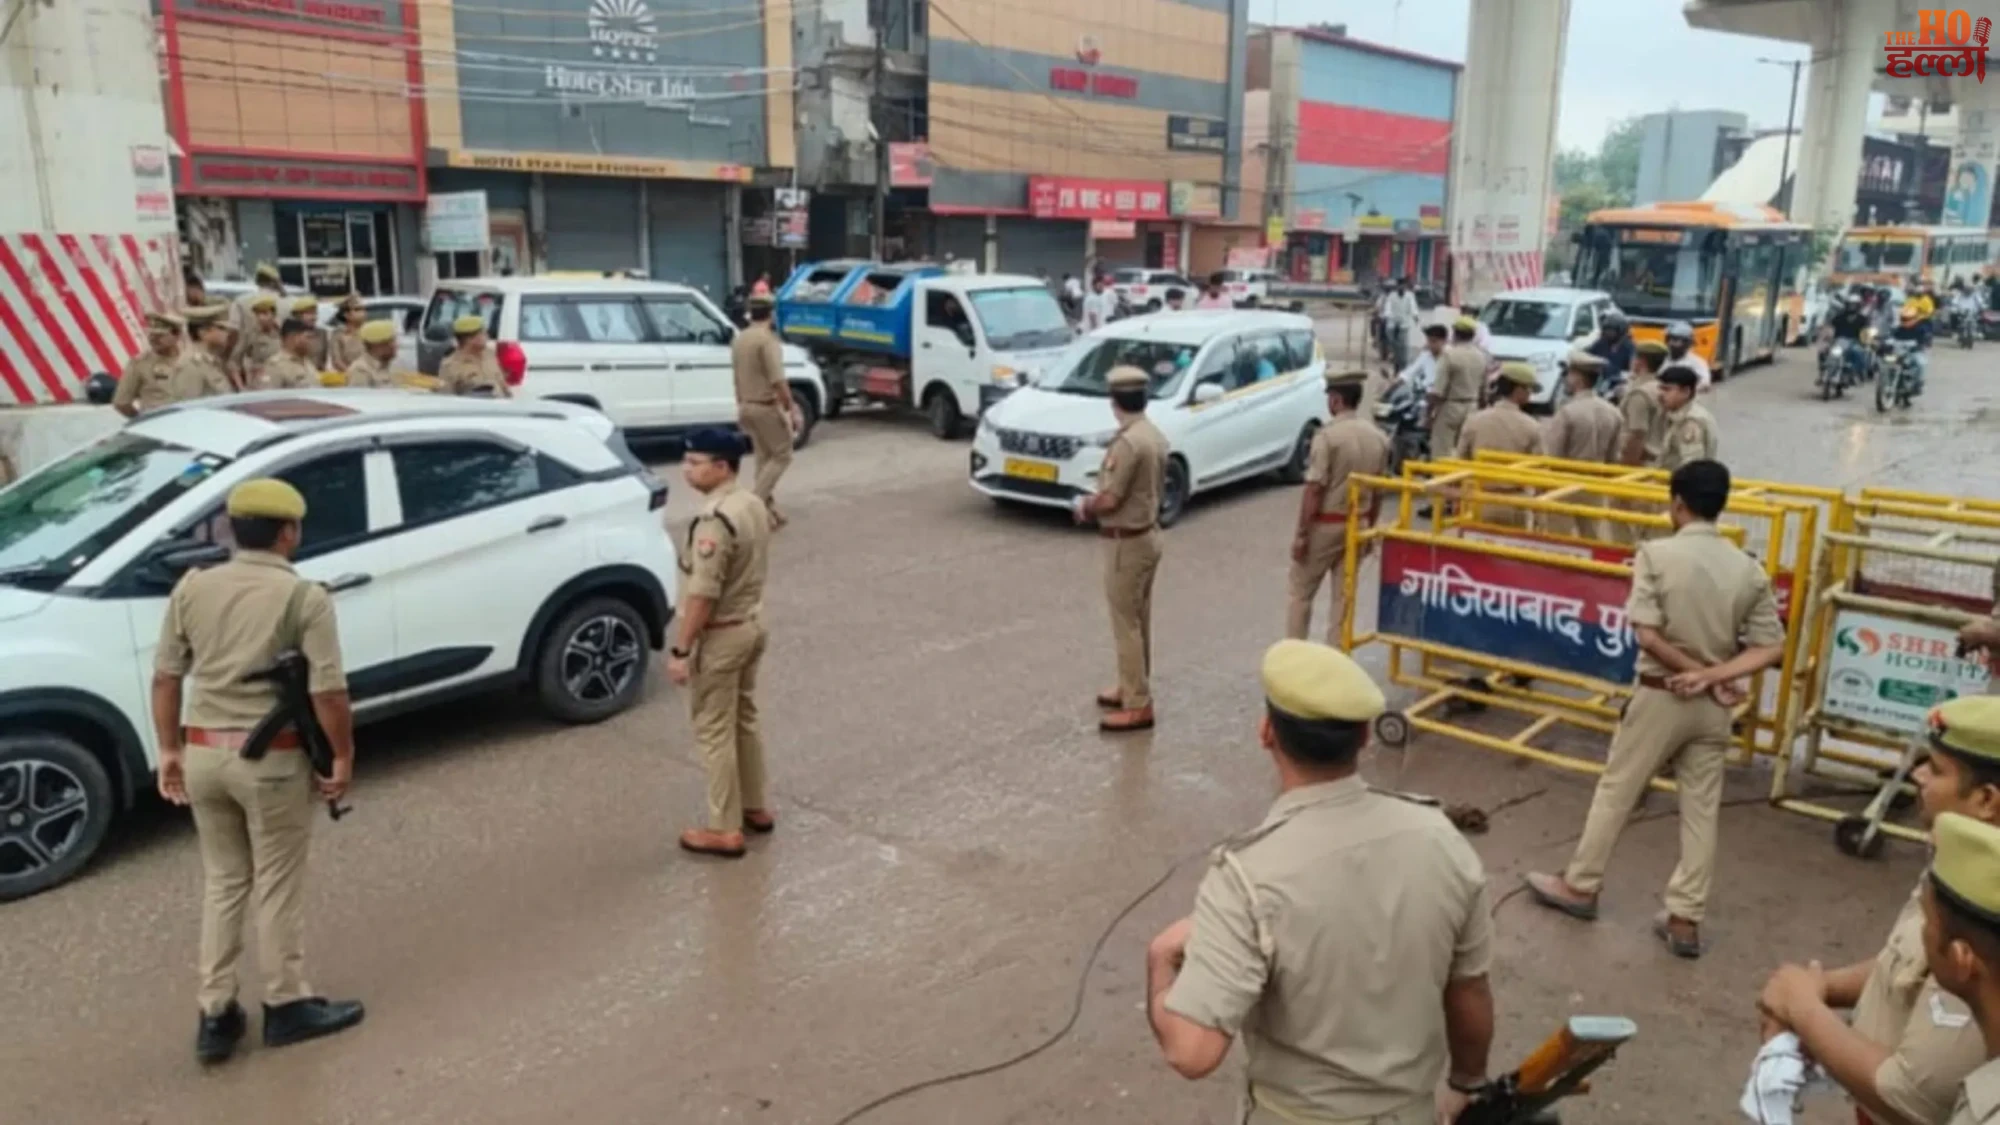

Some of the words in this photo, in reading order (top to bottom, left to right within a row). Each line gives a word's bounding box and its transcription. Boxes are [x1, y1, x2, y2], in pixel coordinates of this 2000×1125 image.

[590, 28, 659, 49] HOTEL
[545, 65, 606, 94] Hotel
[608, 71, 658, 97] Star
[660, 70, 696, 98] Inn
[473, 155, 522, 168] HOTEL
[526, 158, 562, 169] STAR
[1400, 563, 1585, 645] गाजियाबाद
[1886, 632, 1949, 658] SHR
